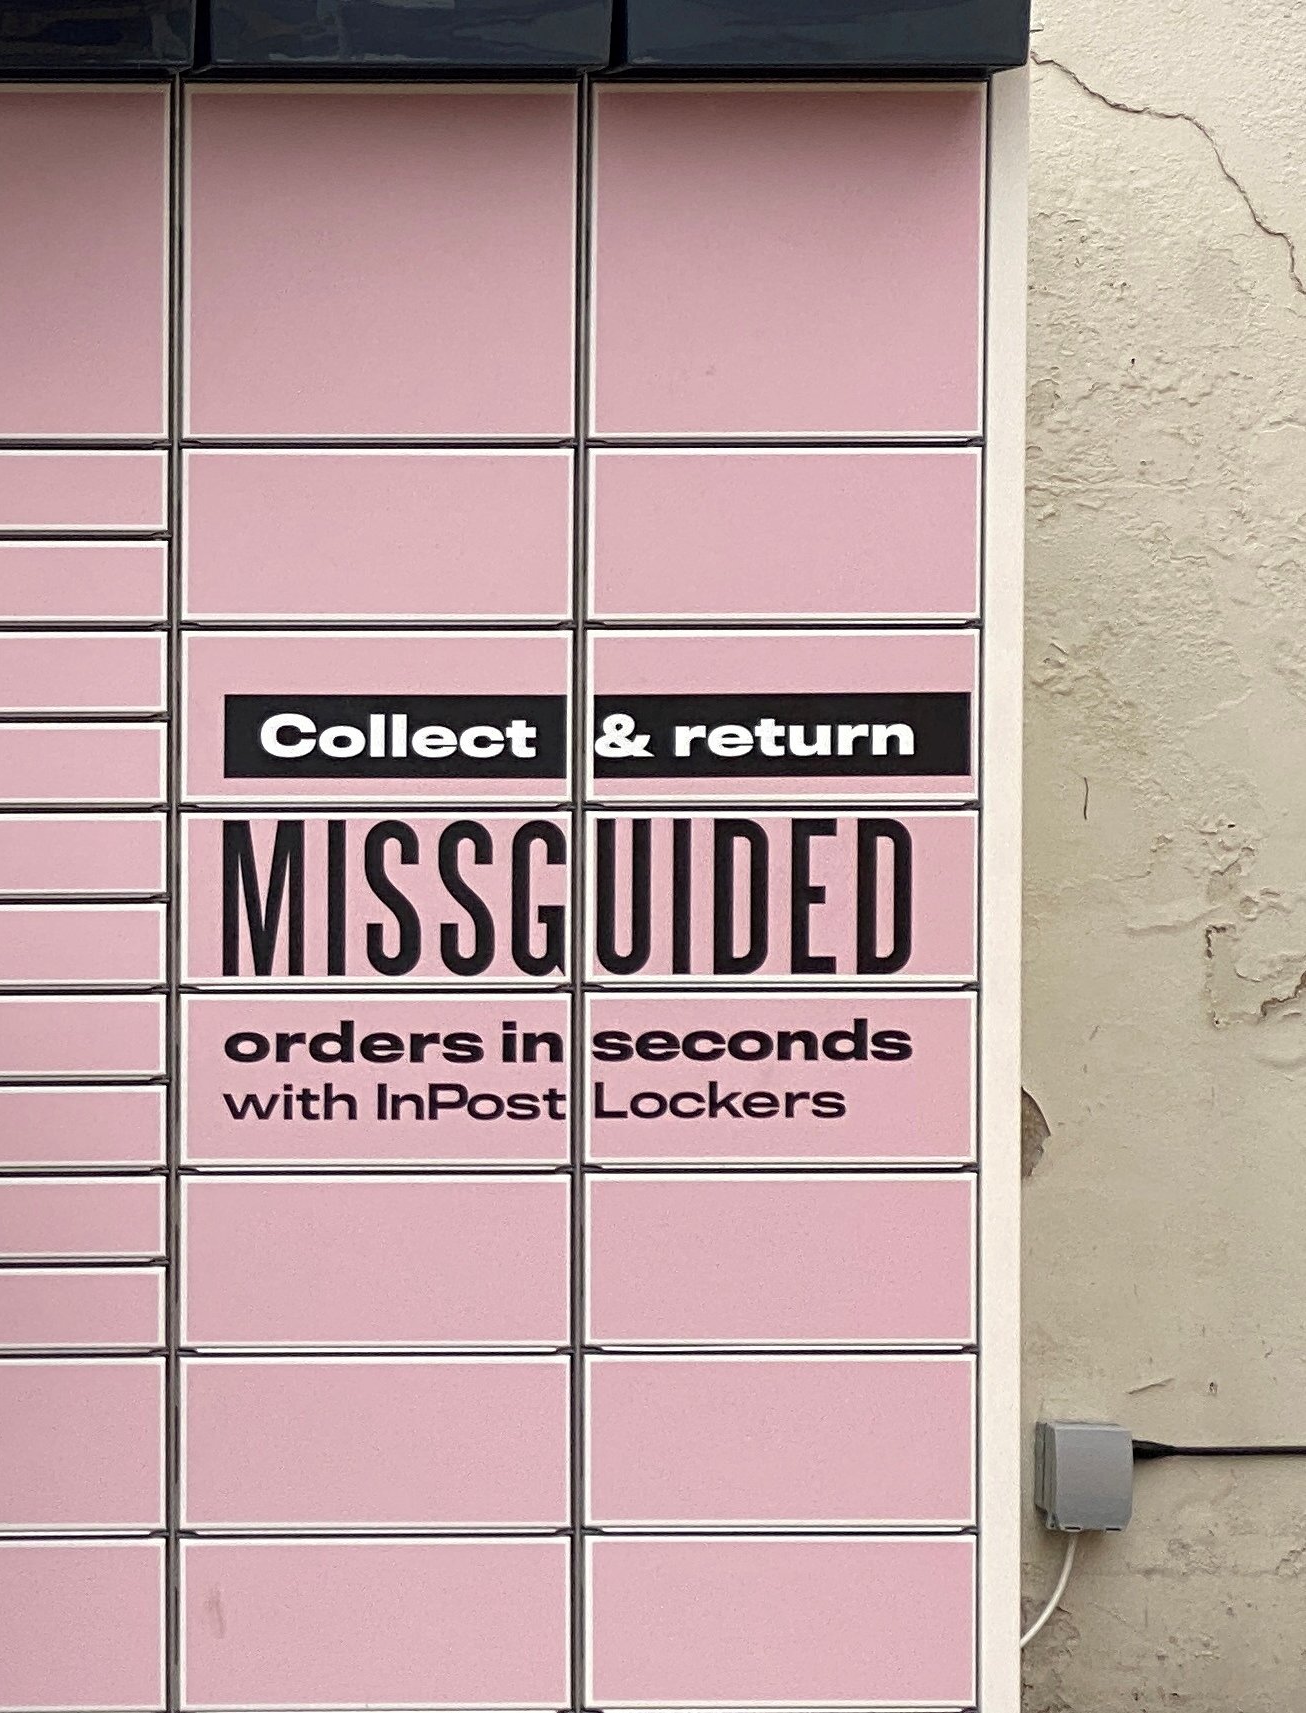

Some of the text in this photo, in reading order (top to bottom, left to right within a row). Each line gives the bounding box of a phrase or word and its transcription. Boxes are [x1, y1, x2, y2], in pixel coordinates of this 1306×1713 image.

[259, 712, 916, 759] Collect & return
[221, 817, 914, 978] MISSGUIDED
[223, 1016, 914, 1065] orders in seconds
[222, 1080, 847, 1122] with InPost Lockers
